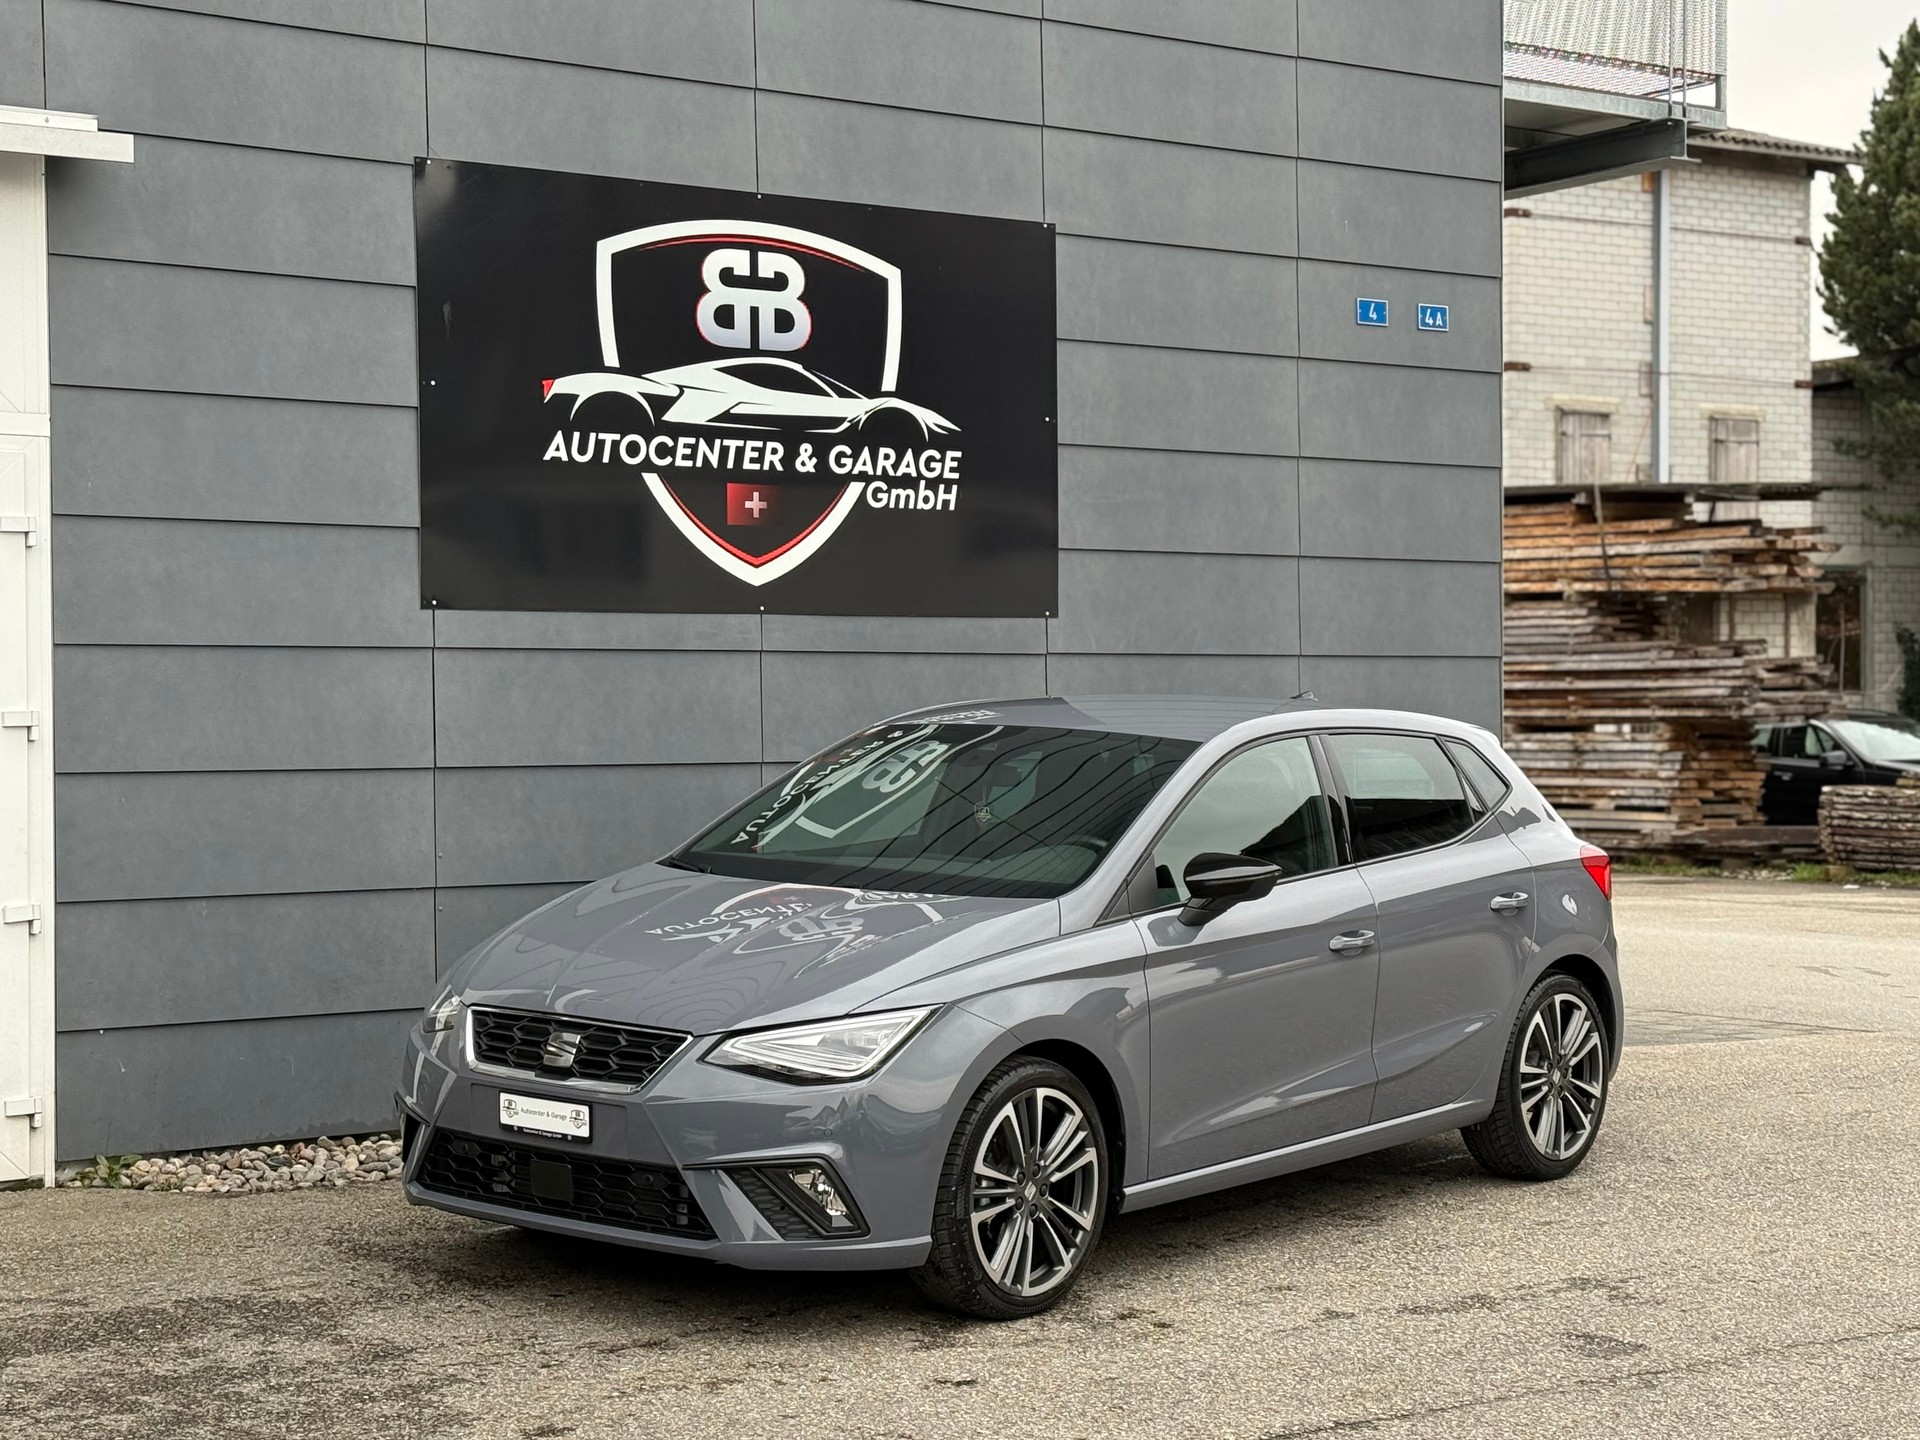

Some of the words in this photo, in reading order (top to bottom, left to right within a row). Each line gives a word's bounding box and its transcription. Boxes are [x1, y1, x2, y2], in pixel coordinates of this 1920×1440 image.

[1368, 302, 1378, 321] 4
[1424, 308, 1444, 327] 4A
[542, 429, 785, 473] AUTOCENTER
[794, 442, 818, 474] &
[828, 448, 962, 479] GARAGE
[865, 480, 959, 512] GmbH
